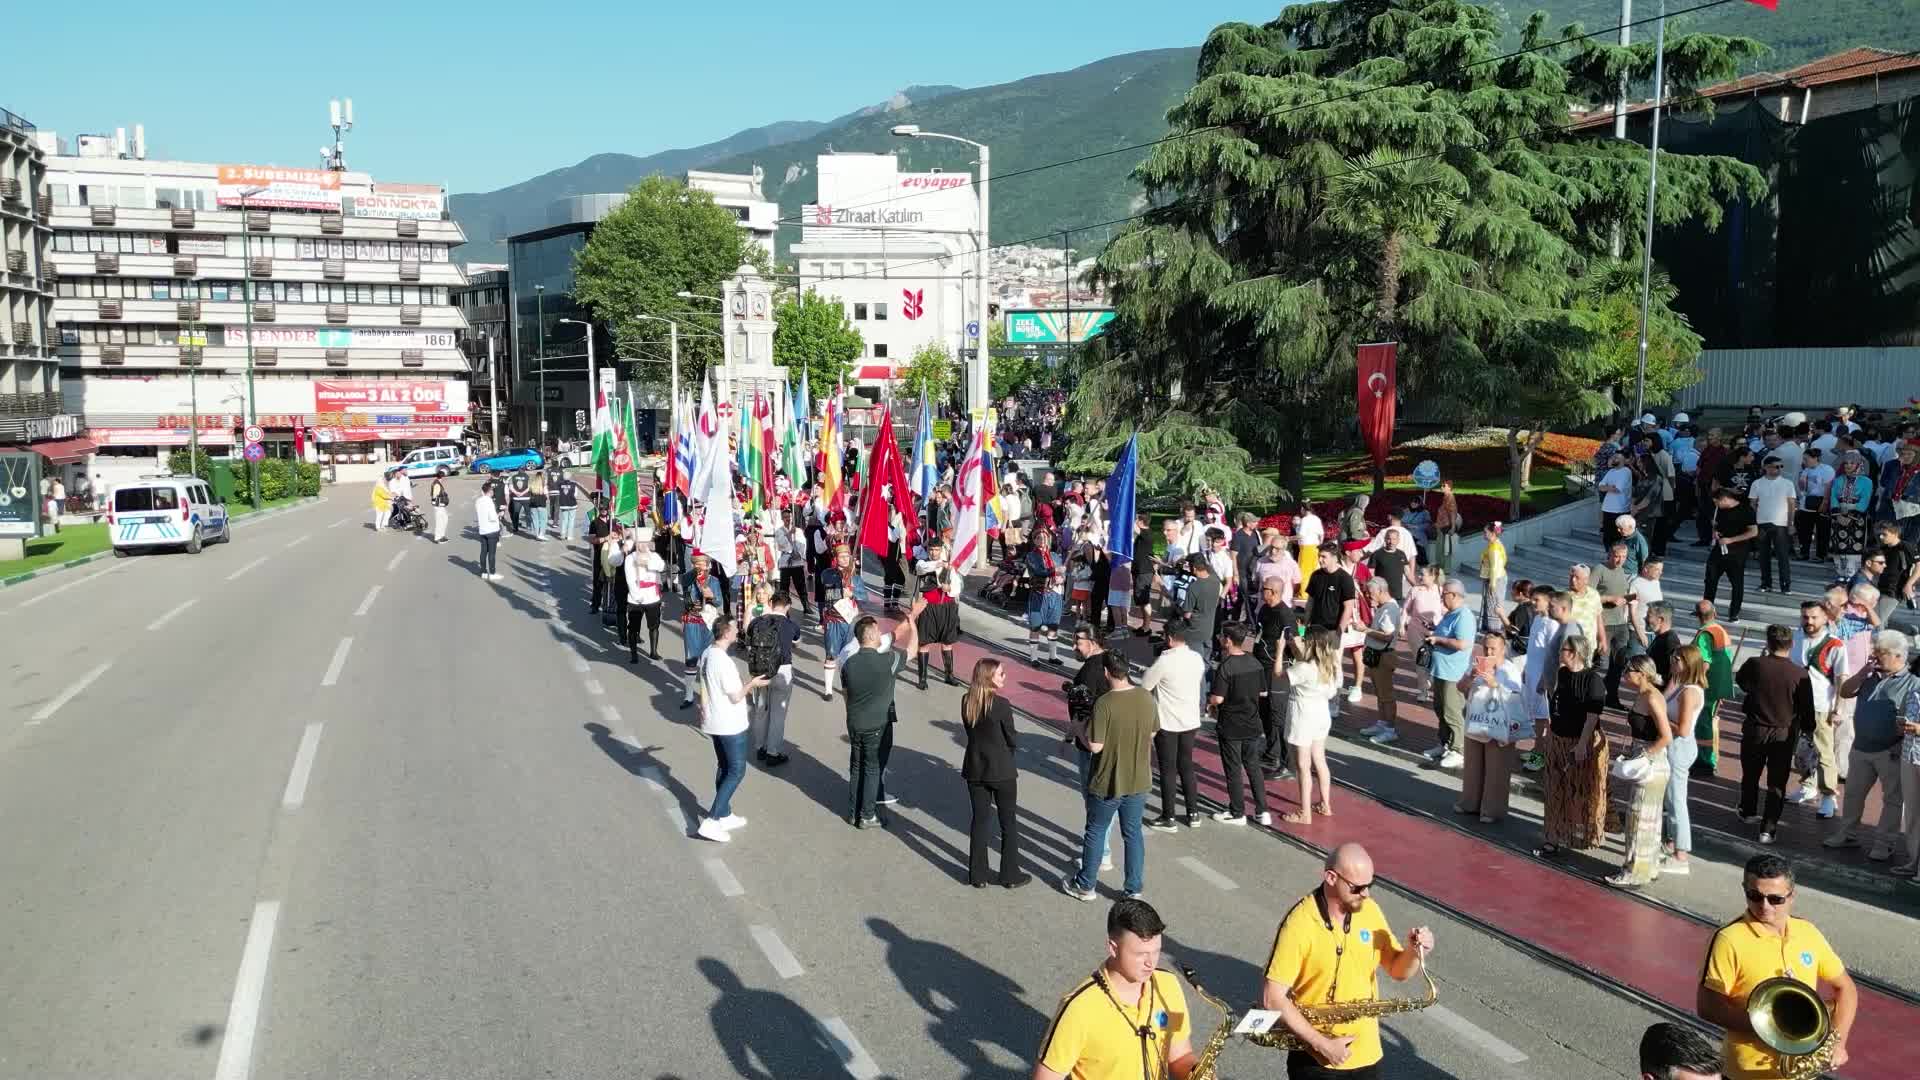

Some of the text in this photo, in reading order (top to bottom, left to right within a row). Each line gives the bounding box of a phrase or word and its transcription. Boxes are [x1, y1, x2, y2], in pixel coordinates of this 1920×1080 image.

[901, 177, 965, 189] evyapar
[391, 199, 437, 209] NOKTA
[836, 208, 922, 223] Ziraat Katılım
[227, 326, 316, 341] İSENDER
[425, 335, 453, 346] 1867
[368, 388, 377, 401] 3
[380, 389, 399, 401] AL
[401, 389, 411, 401] 2
[413, 386, 443, 401] ÖDE
[249, 430, 259, 439] 30
